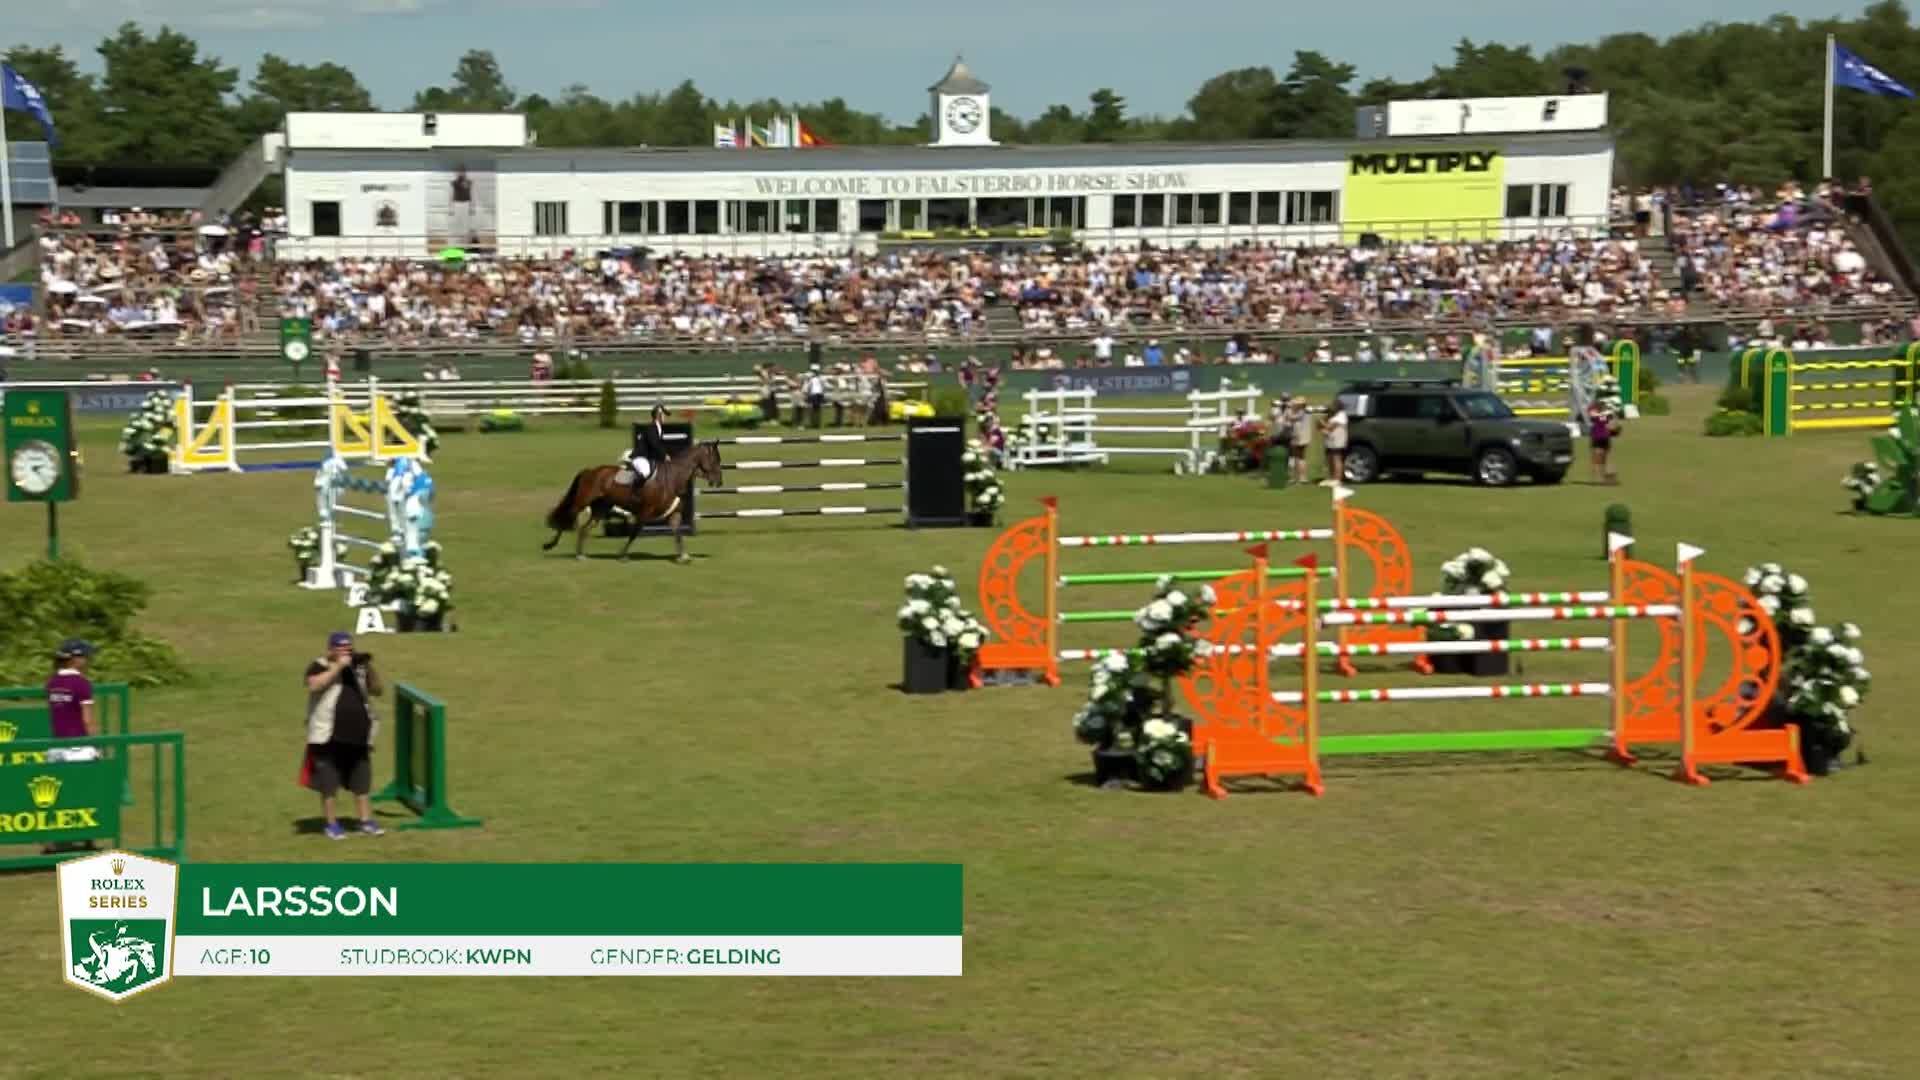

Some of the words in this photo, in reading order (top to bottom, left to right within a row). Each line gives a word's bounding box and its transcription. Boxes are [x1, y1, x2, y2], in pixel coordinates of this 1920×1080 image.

[1351, 150, 1497, 175] MULTIPLY
[754, 176, 869, 195] WELCOME
[876, 176, 910, 194] TO
[915, 174, 1042, 194] FALSTERBO
[1048, 173, 1120, 191] HORSE
[1127, 171, 1187, 191] SHOW
[0, 808, 98, 833] ROLEX
